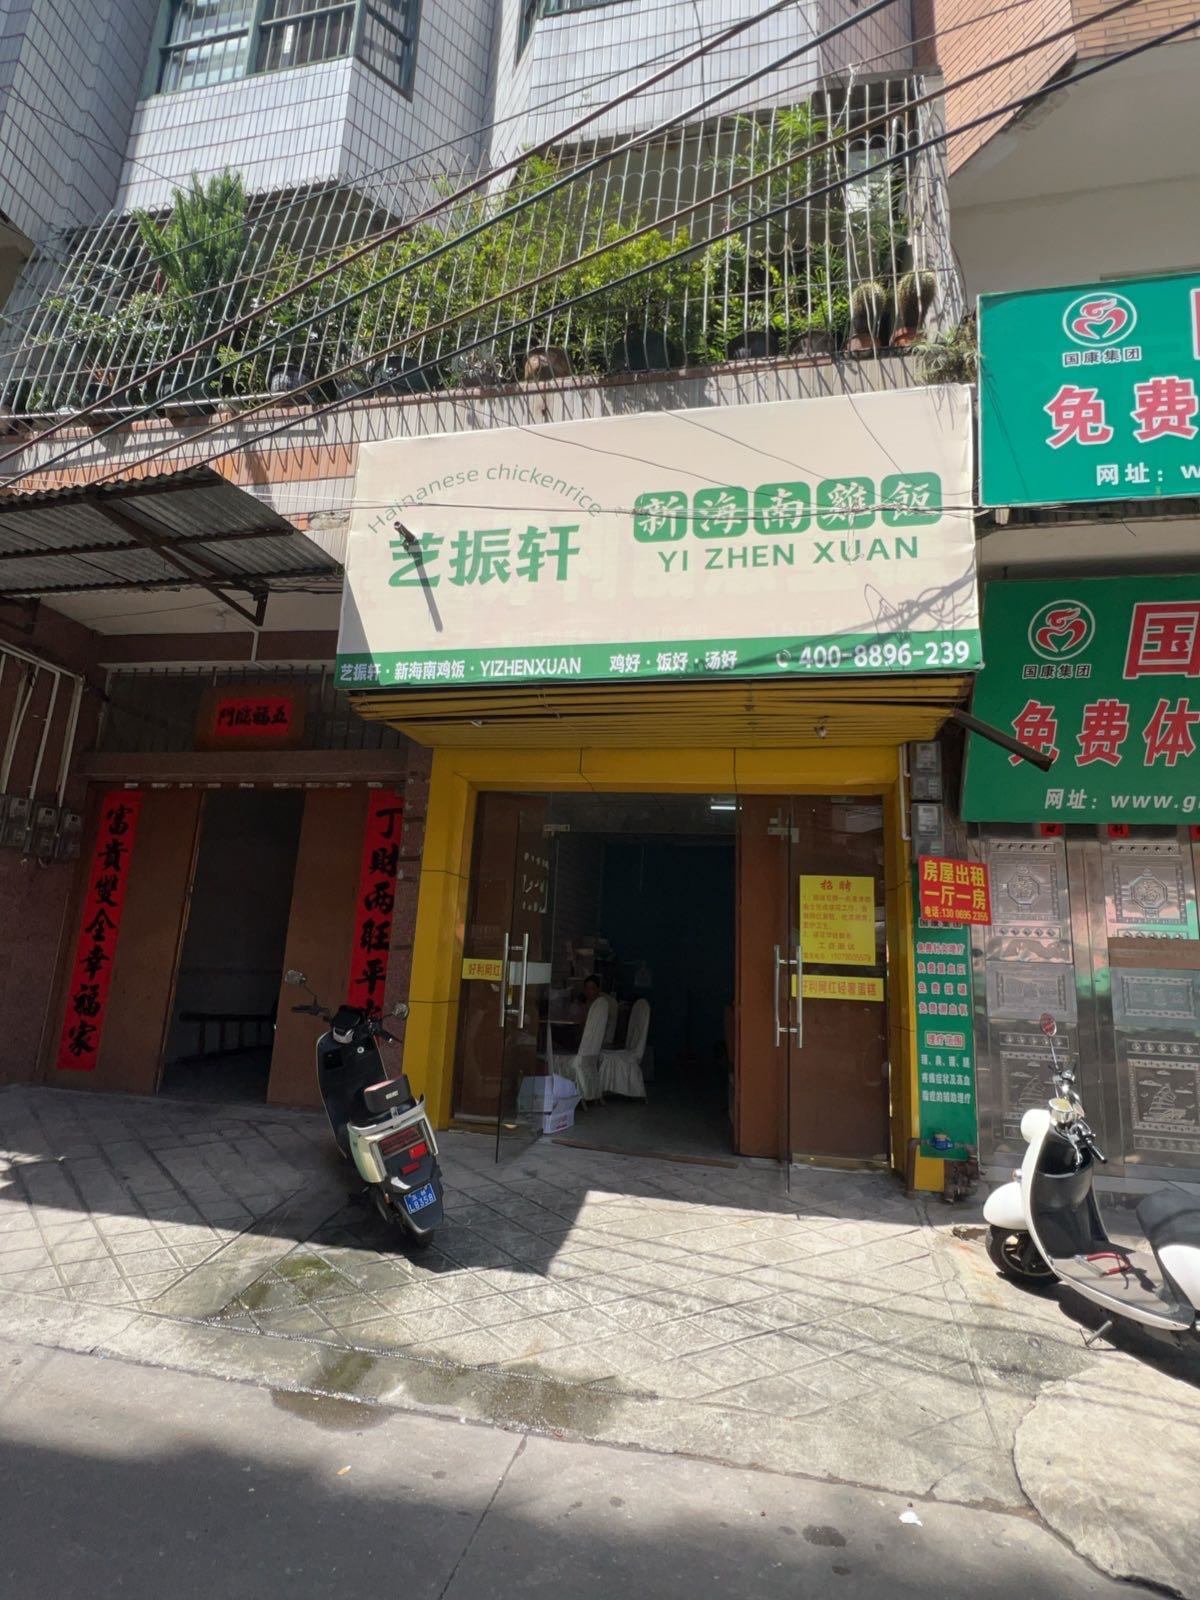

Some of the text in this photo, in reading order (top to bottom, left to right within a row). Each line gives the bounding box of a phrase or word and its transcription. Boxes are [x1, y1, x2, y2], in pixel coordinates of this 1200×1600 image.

[1063, 347, 1142, 367] 国康集团
[1044, 376, 1199, 449] 免费
[368, 463, 601, 534] Hainanese chickenrice
[388, 524, 581, 588] 艺振轩
[658, 536, 919, 573] YI ZHEN XUAN
[800, 640, 970, 670] 400-8896-239
[1022, 664, 1092, 680] 国康集团
[1110, 793, 1200, 814] www.g
[819, 879, 852, 893] 招聘
[924, 860, 985, 888] 房屋出租
[924, 885, 986, 911] 一厅一房
